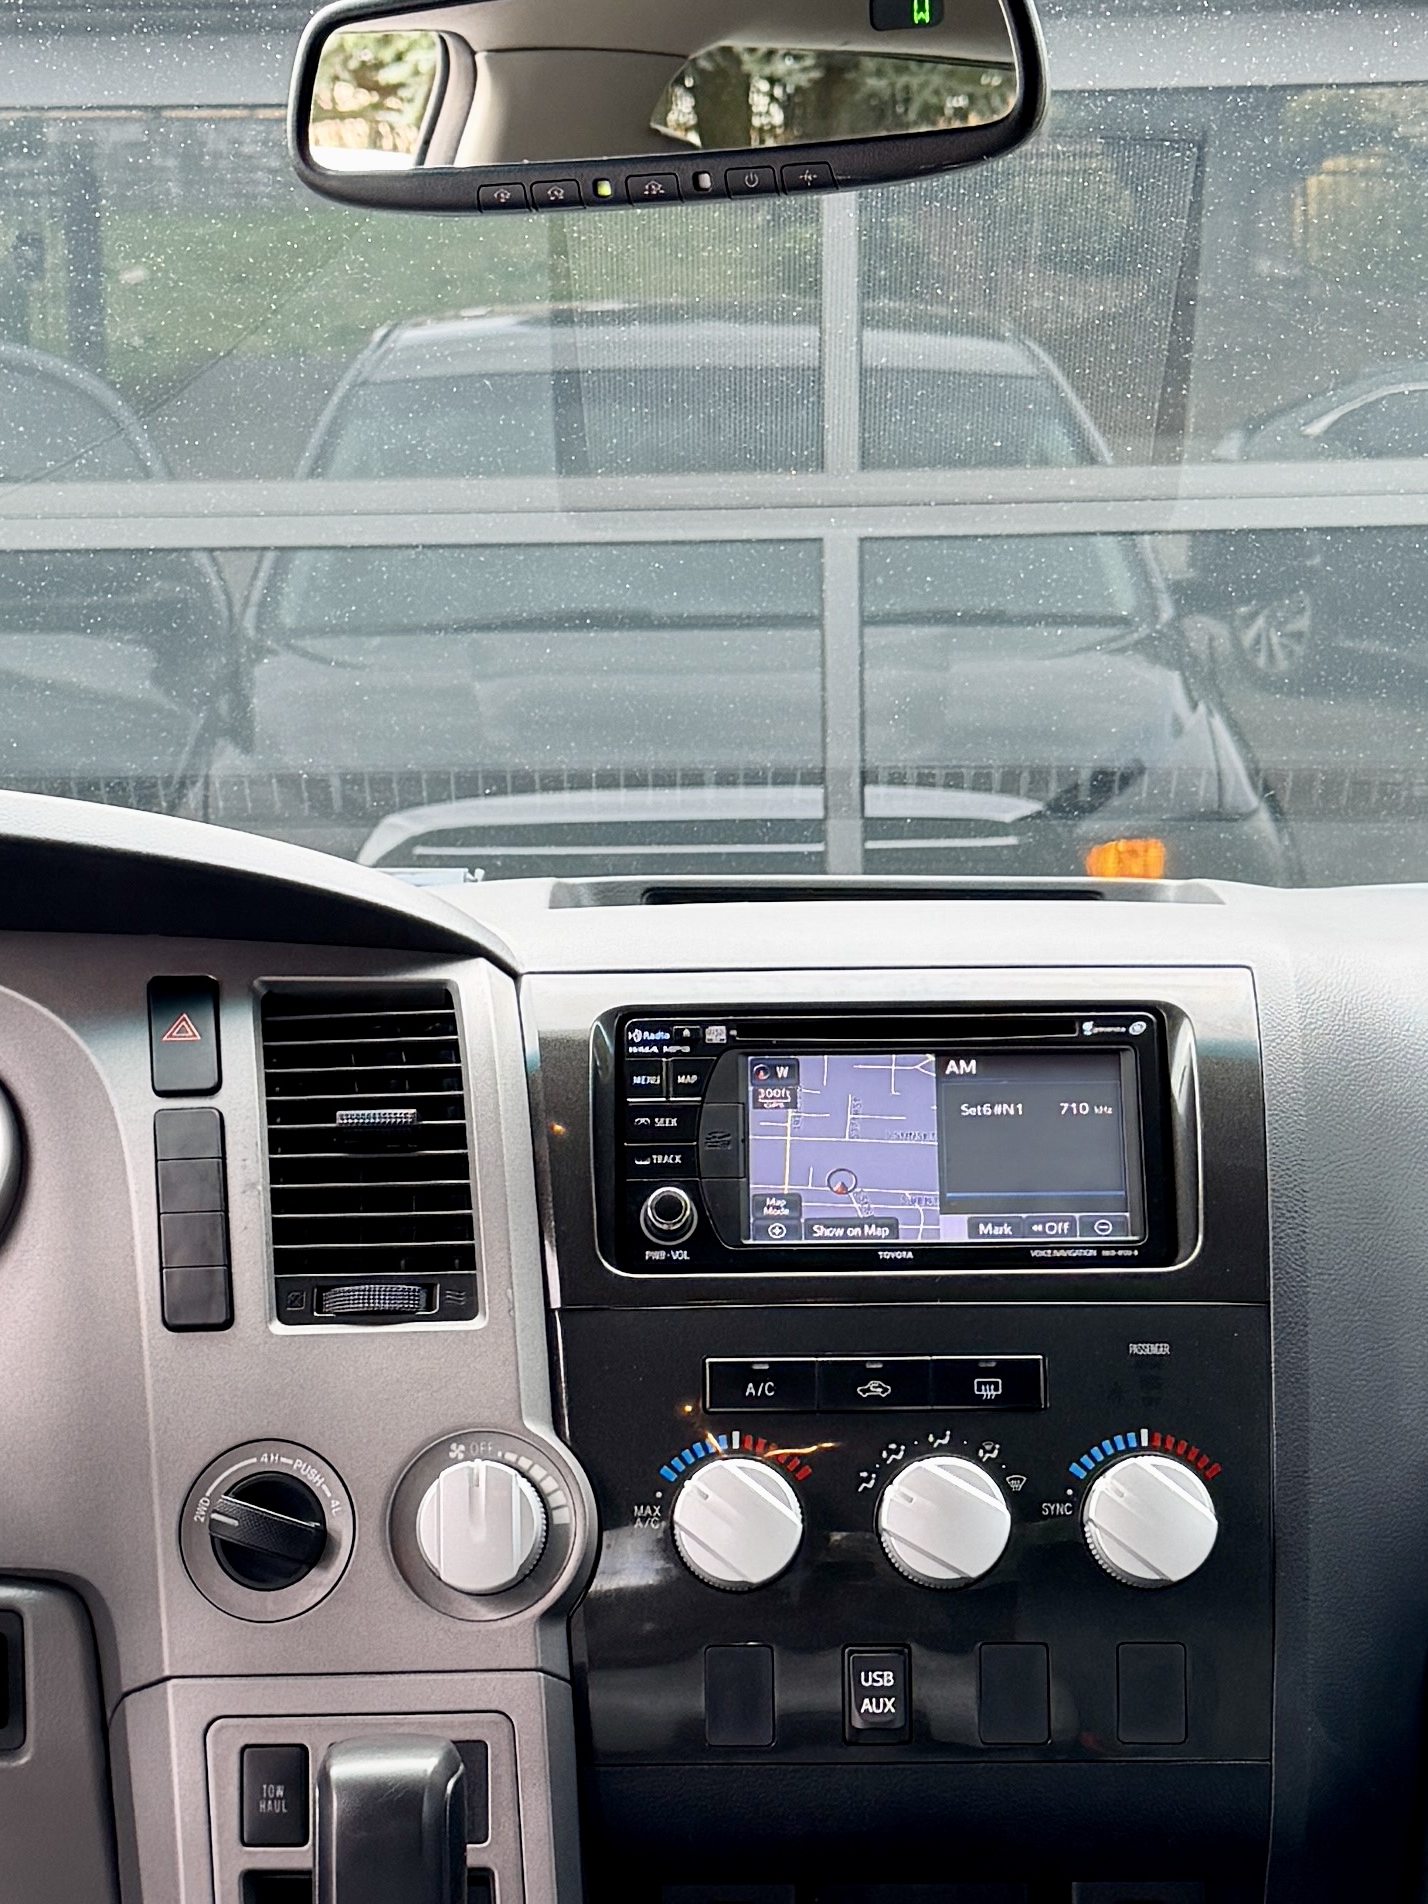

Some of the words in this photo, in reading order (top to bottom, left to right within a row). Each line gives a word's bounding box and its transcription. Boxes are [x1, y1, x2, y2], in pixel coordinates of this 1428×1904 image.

[775, 1066, 789, 1079] W
[945, 1059, 977, 1075] AM
[632, 1075, 661, 1085] MENU
[677, 1075, 698, 1084] MAP
[758, 1088, 791, 1098] 300ft
[1060, 1102, 1089, 1115] 710
[1094, 1105, 1113, 1115] kHz
[654, 1117, 678, 1127] SEEK
[652, 1154, 682, 1164] TRACK
[812, 1224, 844, 1237] Show
[847, 1227, 862, 1237] on
[864, 1224, 890, 1238] Map
[978, 1223, 1013, 1235] Mark
[1045, 1222, 1070, 1235] Off
[877, 1251, 914, 1260] TOYOTA
[1129, 1343, 1171, 1356] PASSENGER
[745, 1382, 775, 1397] A/C
[469, 1441, 493, 1457] OFF
[193, 1495, 211, 1524] 2WD
[260, 1453, 279, 1465] 4H
[292, 1458, 326, 1488] PUSH
[330, 1498, 343, 1517] 4L
[634, 1505, 662, 1517] MAX
[1041, 1502, 1073, 1516] SYNC
[634, 1517, 661, 1529] A/C
[860, 1670, 895, 1687] USB
[860, 1697, 896, 1714] AUX
[262, 1784, 285, 1799] TOW
[259, 1799, 288, 1814] HAUL
